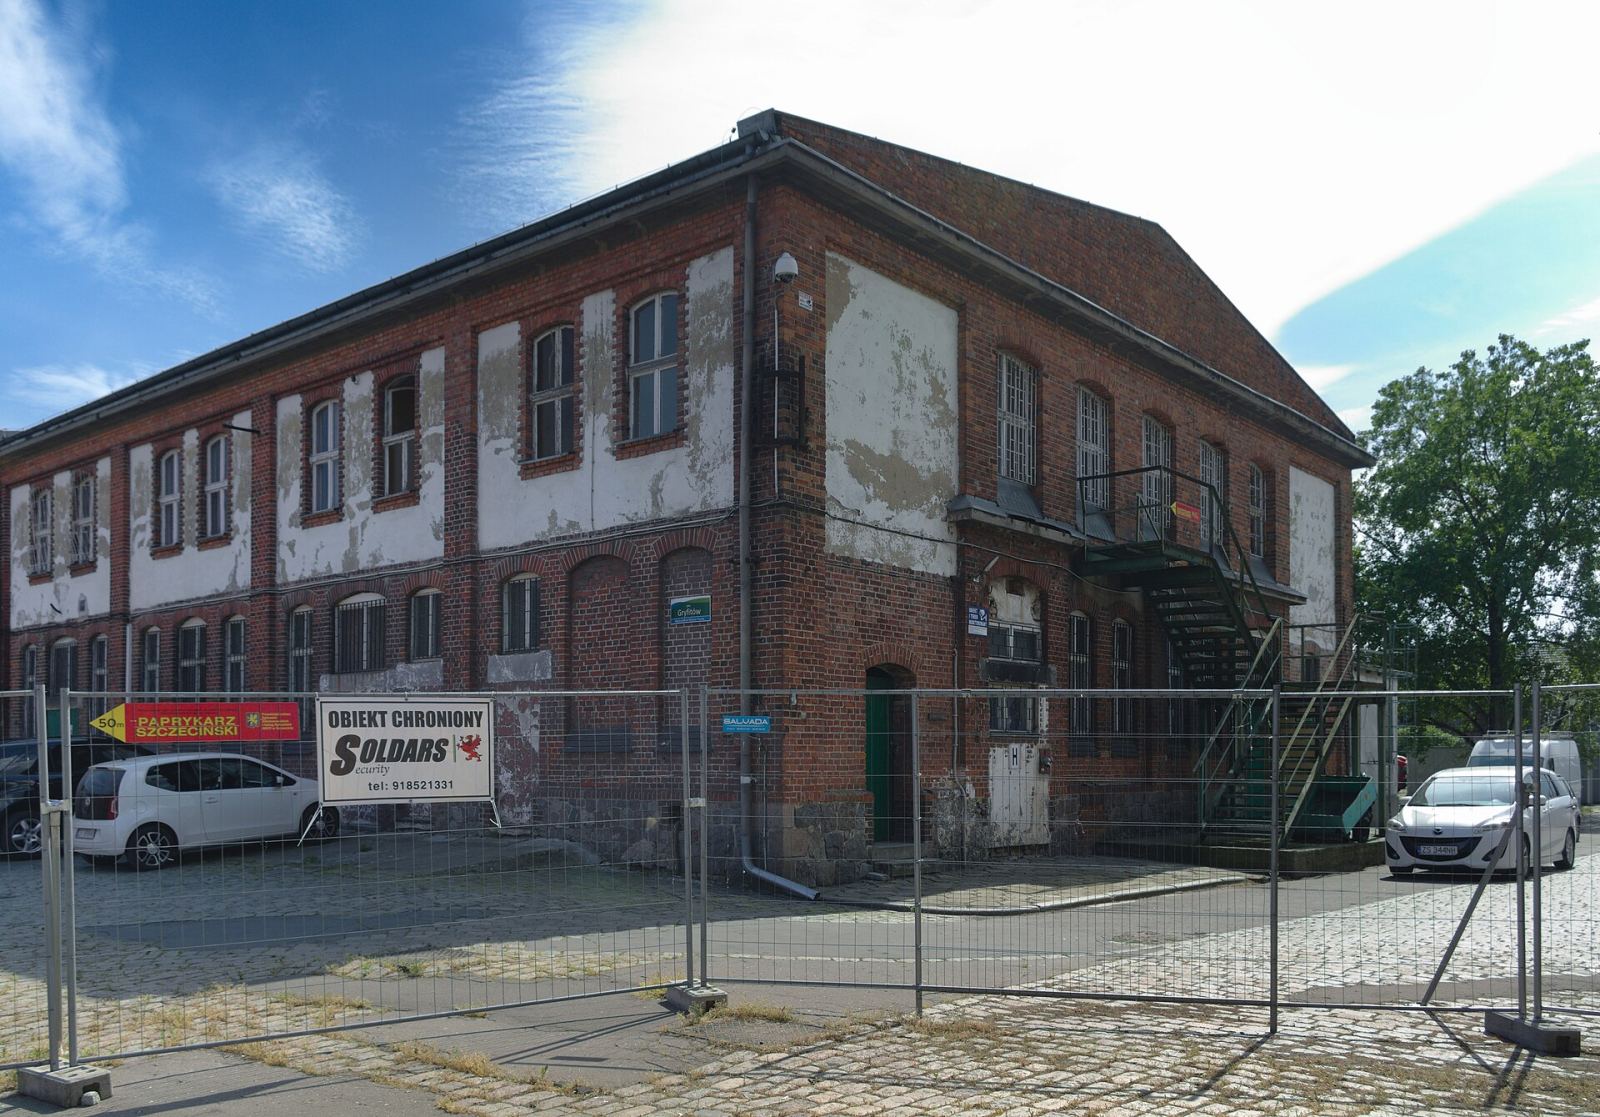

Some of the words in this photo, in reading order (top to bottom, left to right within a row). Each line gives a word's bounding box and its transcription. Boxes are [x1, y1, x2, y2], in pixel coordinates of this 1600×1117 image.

[138, 716, 236, 727] PAPRYKARZ
[328, 710, 388, 728] OBIEKT
[391, 710, 484, 728] CHRONIONY
[329, 734, 450, 776] SOLDARS
[368, 781, 389, 791] tel:
[392, 780, 454, 790] 918521331
